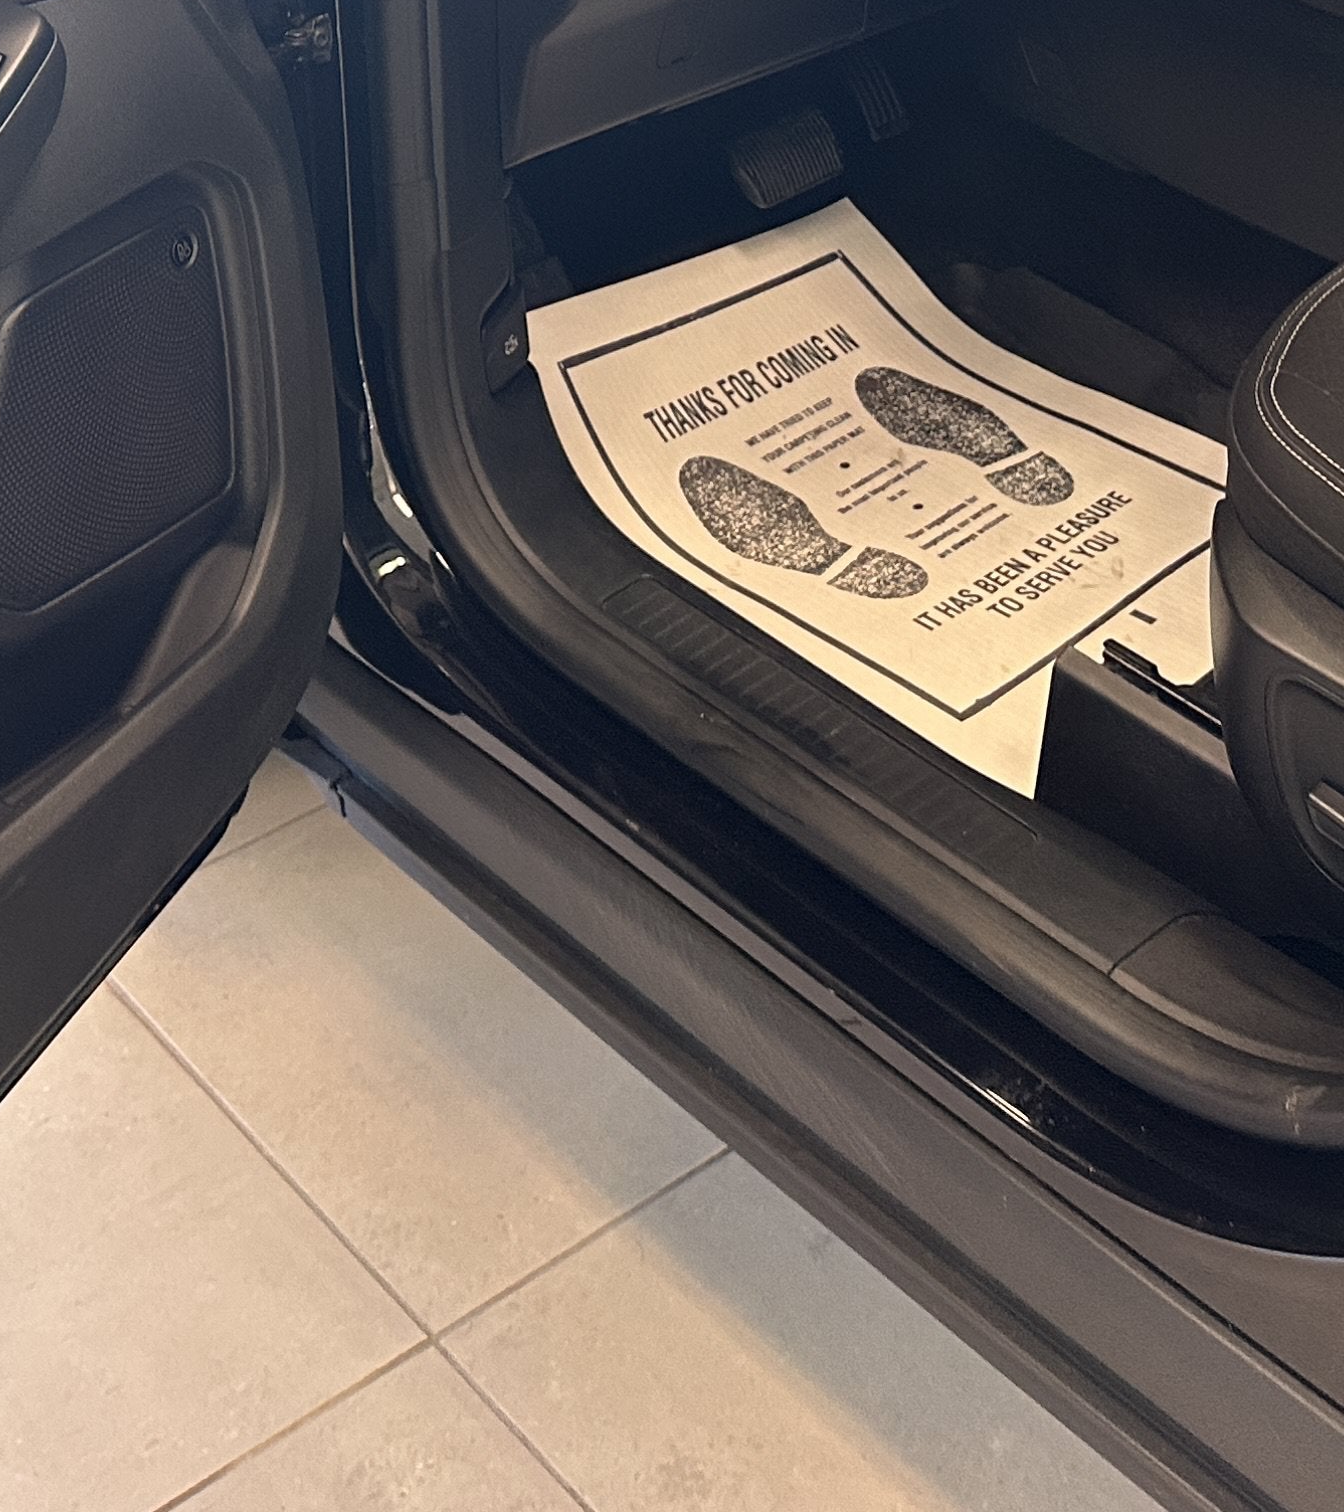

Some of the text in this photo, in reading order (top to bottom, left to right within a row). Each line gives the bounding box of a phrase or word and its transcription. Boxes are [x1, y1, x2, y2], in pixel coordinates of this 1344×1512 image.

[643, 324, 861, 443] THANKS FOR COMING IN
[744, 396, 833, 447] WE HAVE TRIED TO KEEP
[761, 446, 787, 463] YOUR
[825, 411, 853, 429] CLEAN
[783, 425, 866, 474] WITH THIS PAPER MAT
[912, 490, 1133, 631] IT HAS BEEN A PLEASURE
[985, 530, 1120, 618] TO SERVE YOU
